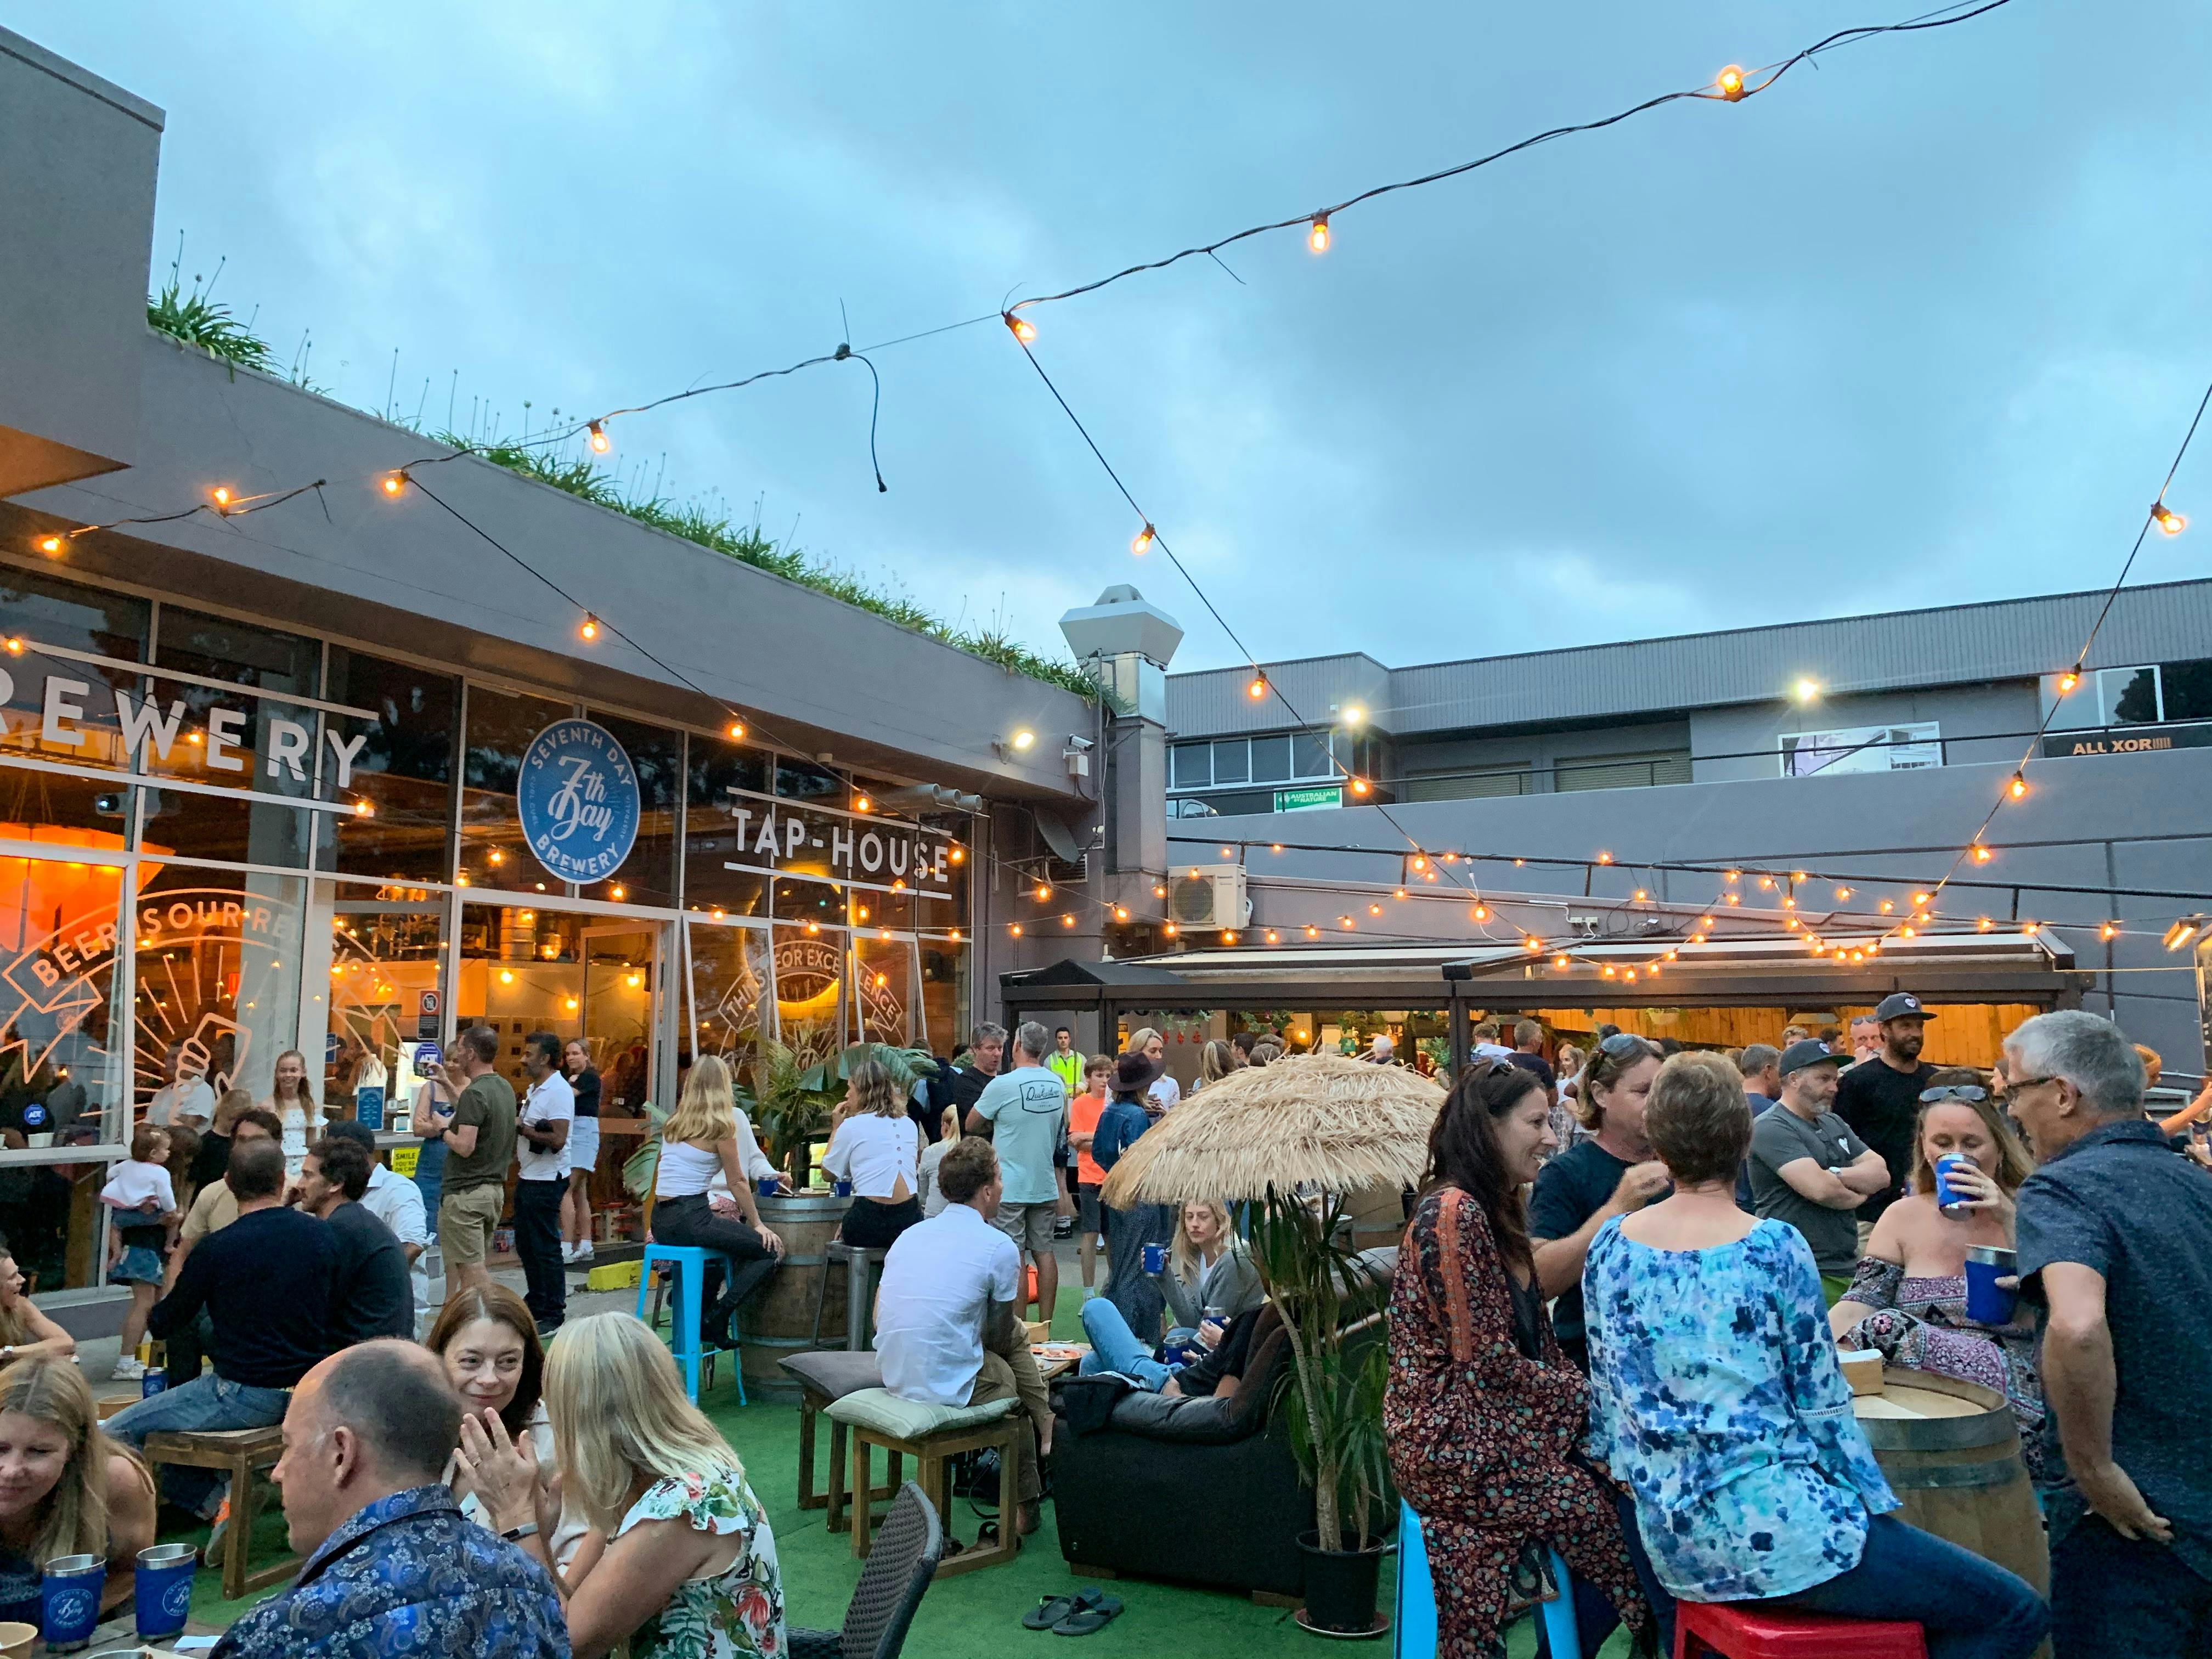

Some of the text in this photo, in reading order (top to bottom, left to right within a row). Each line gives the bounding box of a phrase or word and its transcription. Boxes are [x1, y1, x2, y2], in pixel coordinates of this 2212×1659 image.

[531, 727, 631, 785] SEVENTH DAY
[2073, 742, 2107, 755] ALL
[555, 755, 607, 820] 7th
[1290, 791, 1337, 799] AUSTRALIAN
[548, 789, 614, 841] Day
[619, 795, 631, 839] AUSTRALIA
[536, 834, 619, 875] BREWERY
[31, 922, 122, 988] BEER
[168, 901, 241, 929] OUR
[774, 949, 803, 968] FOR
[807, 949, 897, 1020] EXCELENCE
